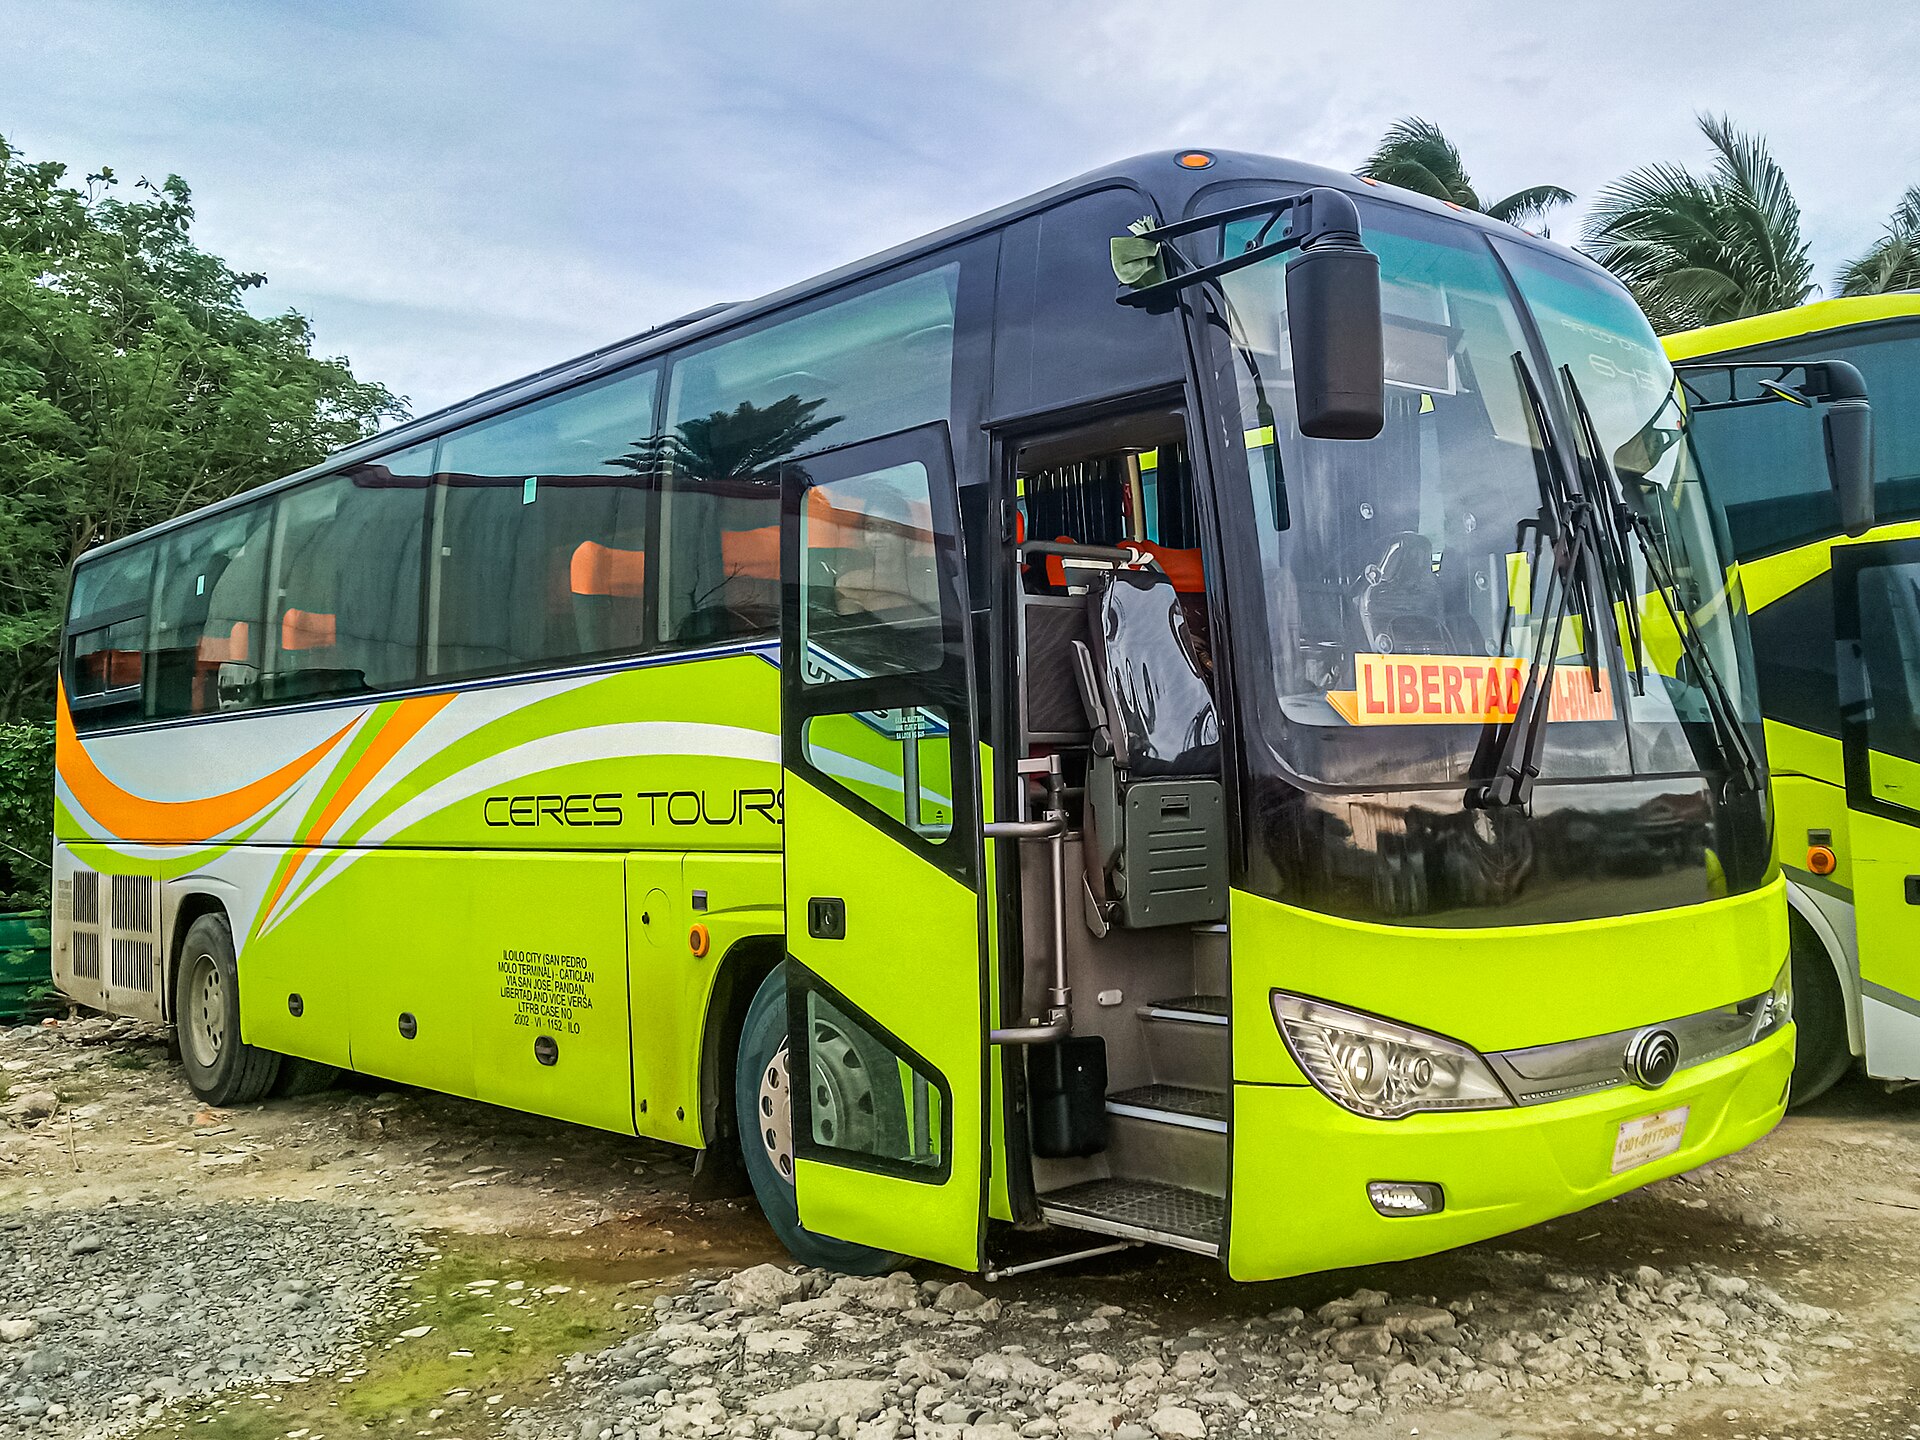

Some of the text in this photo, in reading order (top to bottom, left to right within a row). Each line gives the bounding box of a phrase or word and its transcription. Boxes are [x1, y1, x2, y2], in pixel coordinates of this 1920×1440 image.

[1364, 663, 1525, 715] LIBERTAD
[484, 788, 784, 827] CERES TOUR
[503, 949, 588, 969] ILOILO CITY (SAN PEDRO
[498, 961, 517, 974] MOLO
[518, 963, 555, 980] TERMINAL)
[559, 968, 595, 983] CATICLAN
[505, 975, 517, 986] VIA
[518, 976, 532, 989] SAN
[500, 986, 593, 1009] LIBERTAD AND VICE VERSA
[518, 1001, 573, 1020] LTFRB CASE NO
[534, 1016, 542, 1027] VI
[547, 1018, 563, 1032] 1152
[567, 1021, 581, 1034] ILO
